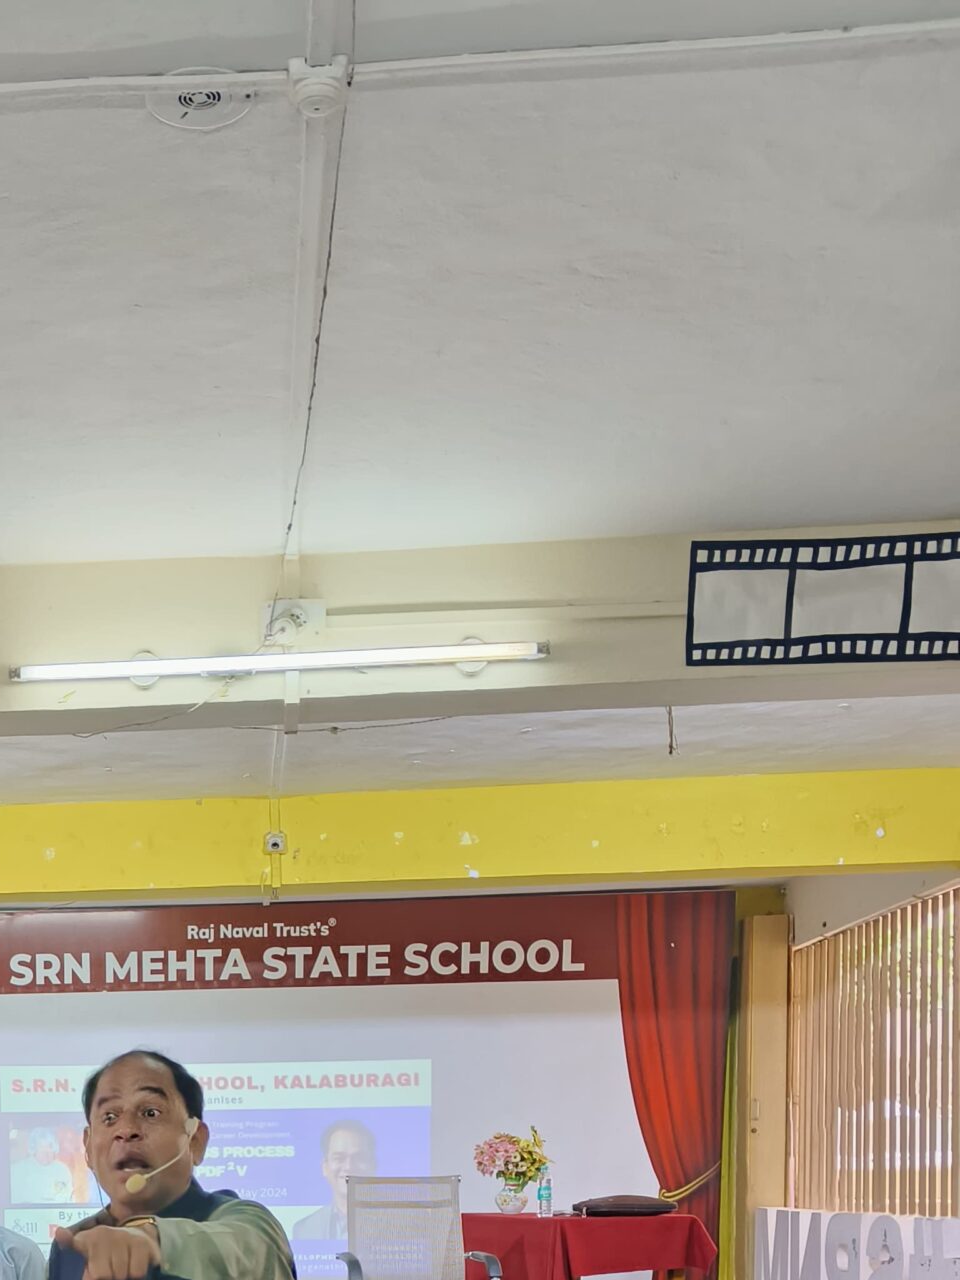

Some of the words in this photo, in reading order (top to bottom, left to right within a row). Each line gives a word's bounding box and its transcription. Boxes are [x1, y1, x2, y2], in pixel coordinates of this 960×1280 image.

[187, 924, 215, 943] Raj
[219, 923, 268, 940] Naval
[9, 952, 91, 987] SRN
[105, 948, 252, 984] MEHTA
[262, 944, 391, 980] STATE
[403, 938, 585, 976] SCHOOL
[11, 1078, 77, 1093] S.R.N.
[198, 1075, 265, 1094] HOOL,
[273, 1072, 420, 1090] KALABURAGI
[206, 1095, 244, 1105] anises
[223, 1145, 295, 1158] PROCESS
[259, 1187, 288, 1198] 2024
[58, 1211, 73, 1222] By
